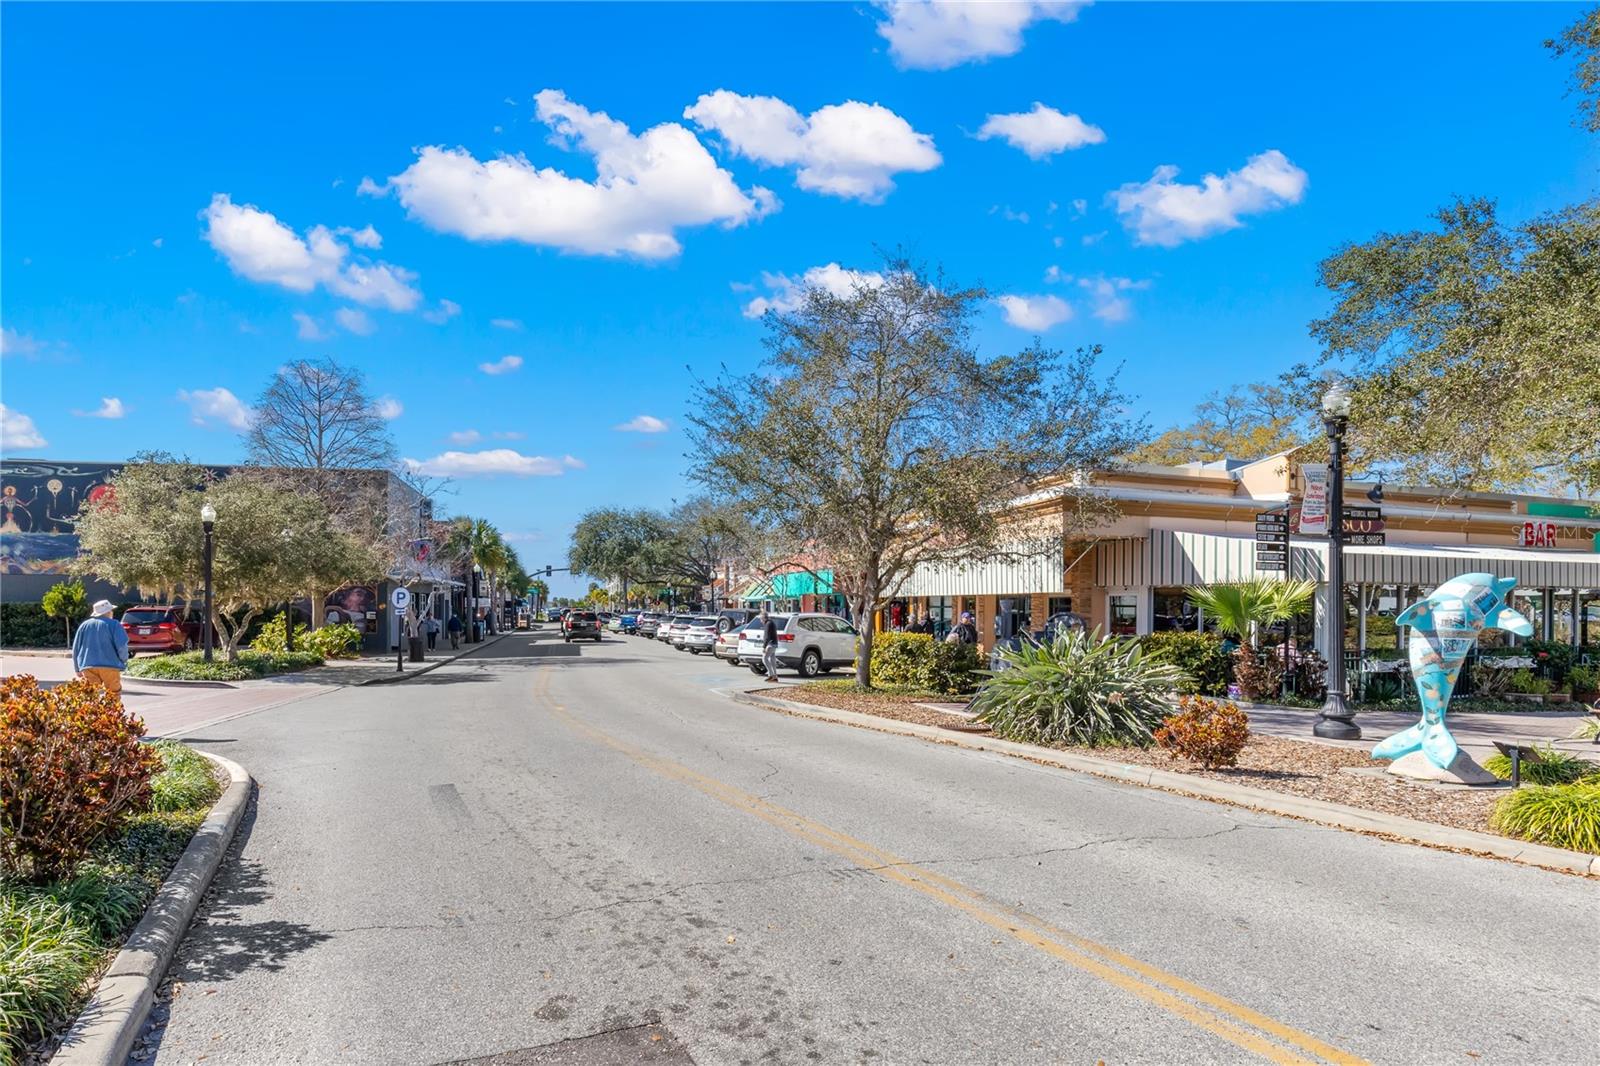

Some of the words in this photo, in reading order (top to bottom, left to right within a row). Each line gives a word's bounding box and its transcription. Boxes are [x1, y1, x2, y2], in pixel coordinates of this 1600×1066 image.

[1351, 535, 1365, 544] MORE
[1366, 535, 1383, 545] SHOPS
[1522, 521, 1557, 547] BAR
[396, 591, 406, 604] P
